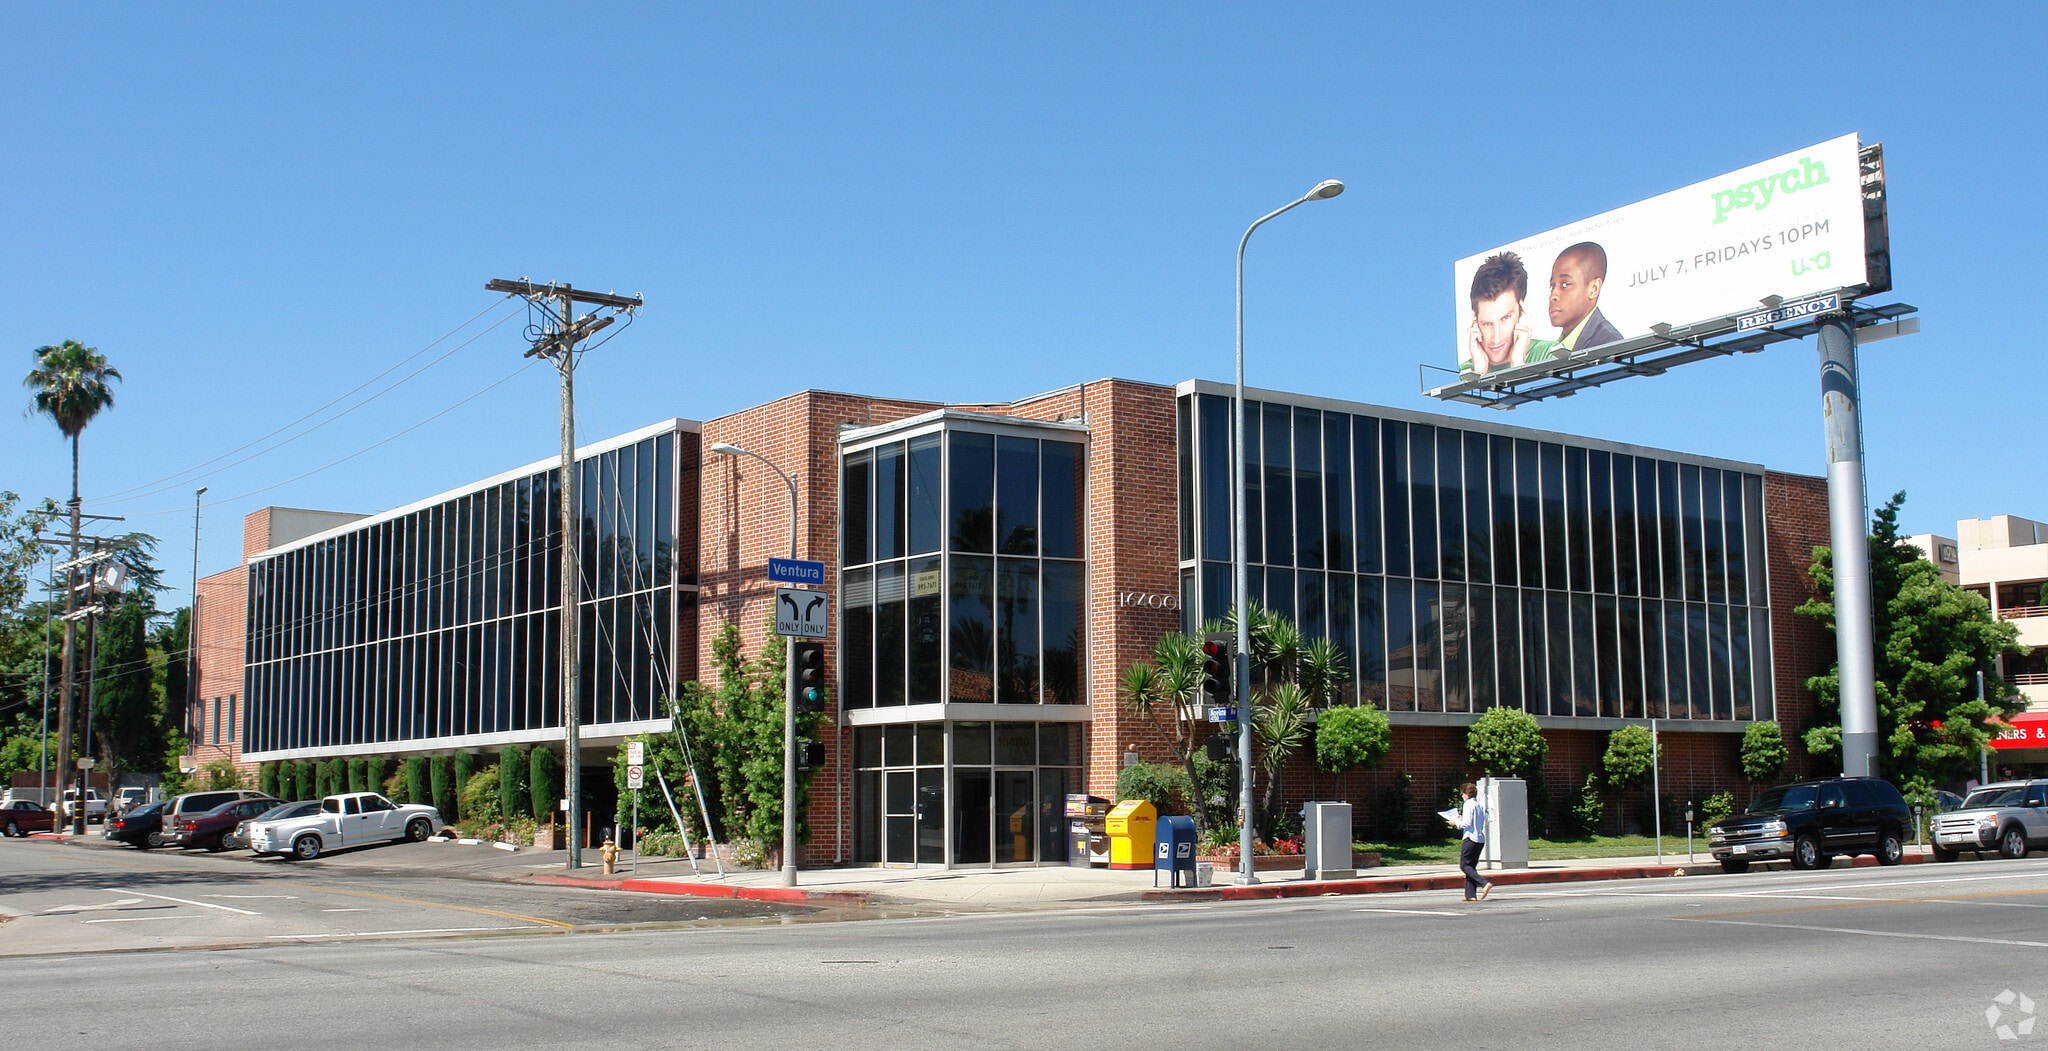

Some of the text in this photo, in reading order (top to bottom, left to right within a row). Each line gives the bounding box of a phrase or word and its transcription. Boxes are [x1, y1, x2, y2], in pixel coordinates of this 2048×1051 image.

[1711, 156, 1832, 225] psych
[1629, 218, 1830, 288] JULY 7, FRIDAYS 10PM
[1740, 296, 1835, 329] REGENCY
[773, 563, 819, 579] Ventura
[1120, 591, 1177, 610] 16400
[780, 621, 800, 632] ONLY
[804, 623, 825, 634] ONLY
[1996, 727, 2047, 741] NERS &
